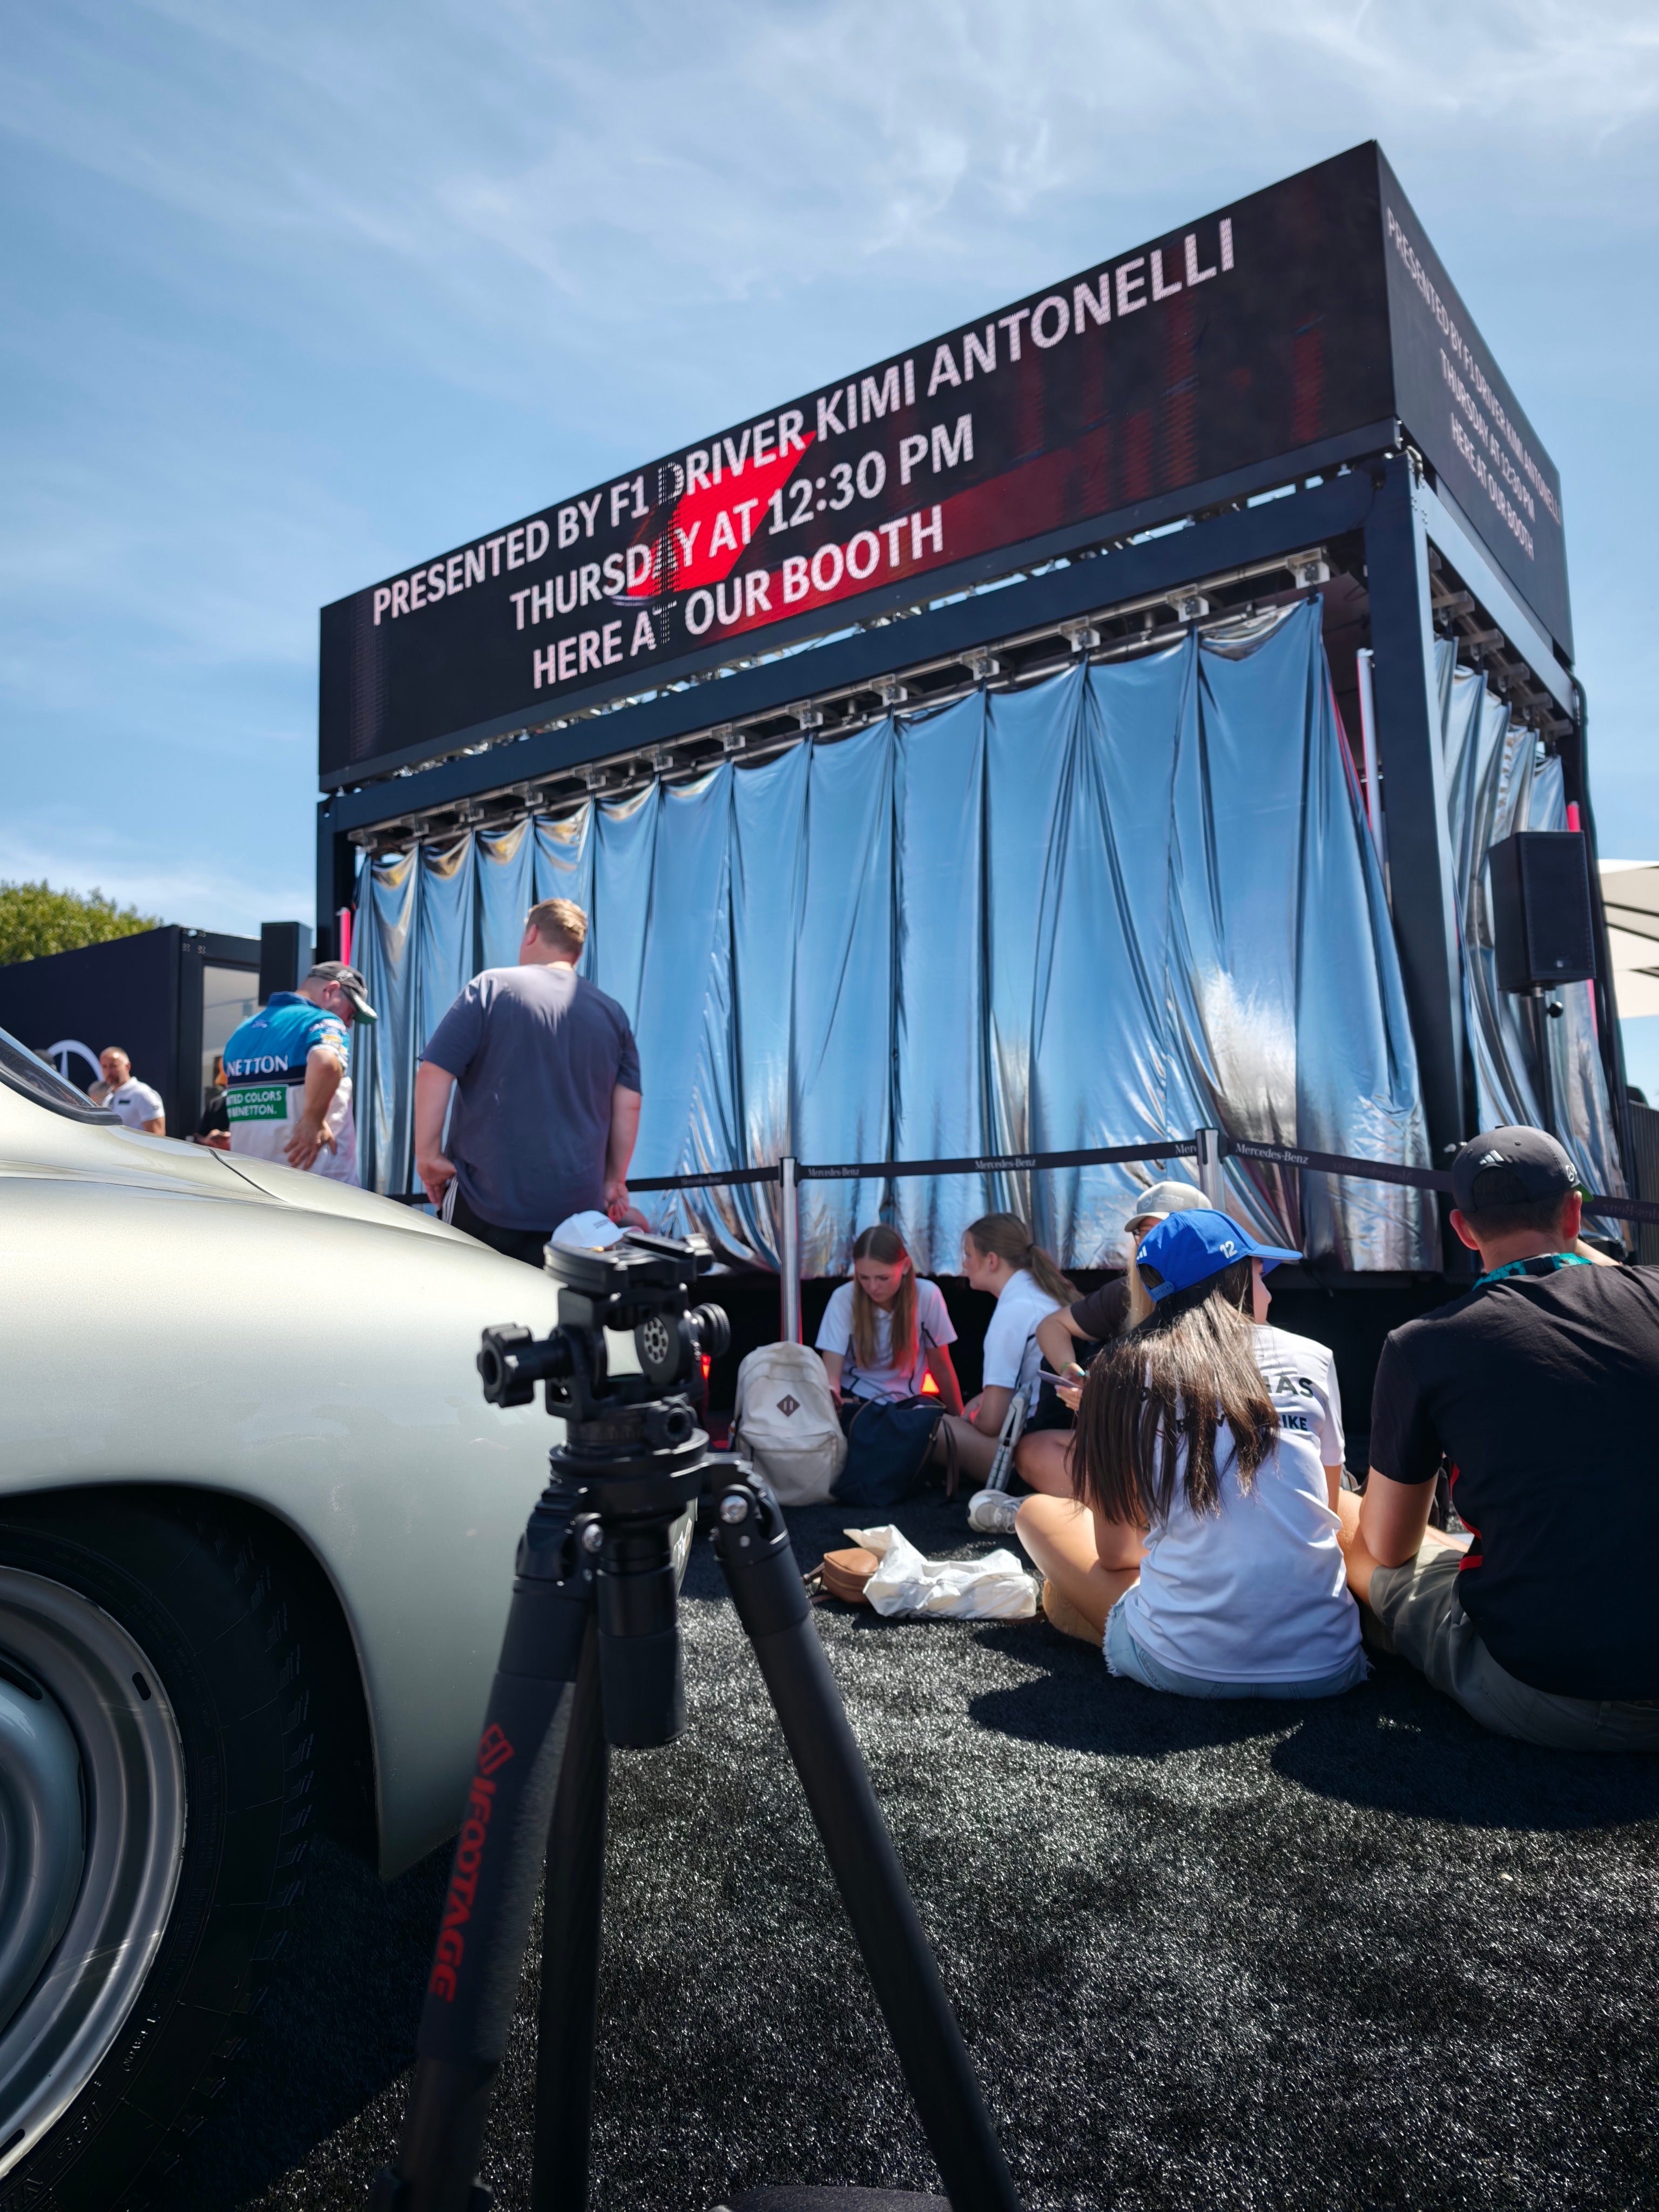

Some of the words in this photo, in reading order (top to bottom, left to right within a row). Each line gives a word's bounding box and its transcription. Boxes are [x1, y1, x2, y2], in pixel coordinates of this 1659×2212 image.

[1386, 205, 1449, 336] PRESENTED
[1449, 319, 1462, 360] BY
[374, 520, 549, 626] PRESENTED
[557, 493, 602, 549] BY
[611, 475, 649, 527] F1
[658, 409, 806, 505] DRIVER
[817, 359, 915, 442] KIMI
[927, 217, 1234, 397] ANTONELLI
[1451, 412, 1477, 473] HERE
[1477, 454, 1487, 490] AT
[1490, 433, 1500, 467] AT
[509, 521, 701, 631] THURSDAY
[709, 498, 758, 558] AT
[768, 450, 886, 535] 12:30
[899, 413, 974, 485] PM
[533, 620, 623, 689] HERE
[630, 599, 677, 656] AT
[685, 569, 772, 635] OUR
[783, 504, 943, 604] BOOTH
[244, 1090, 282, 1104] COLORS
[1235, 1142, 1309, 1165] Mercedes-Benz
[1219, 1240, 1238, 1259] 12
